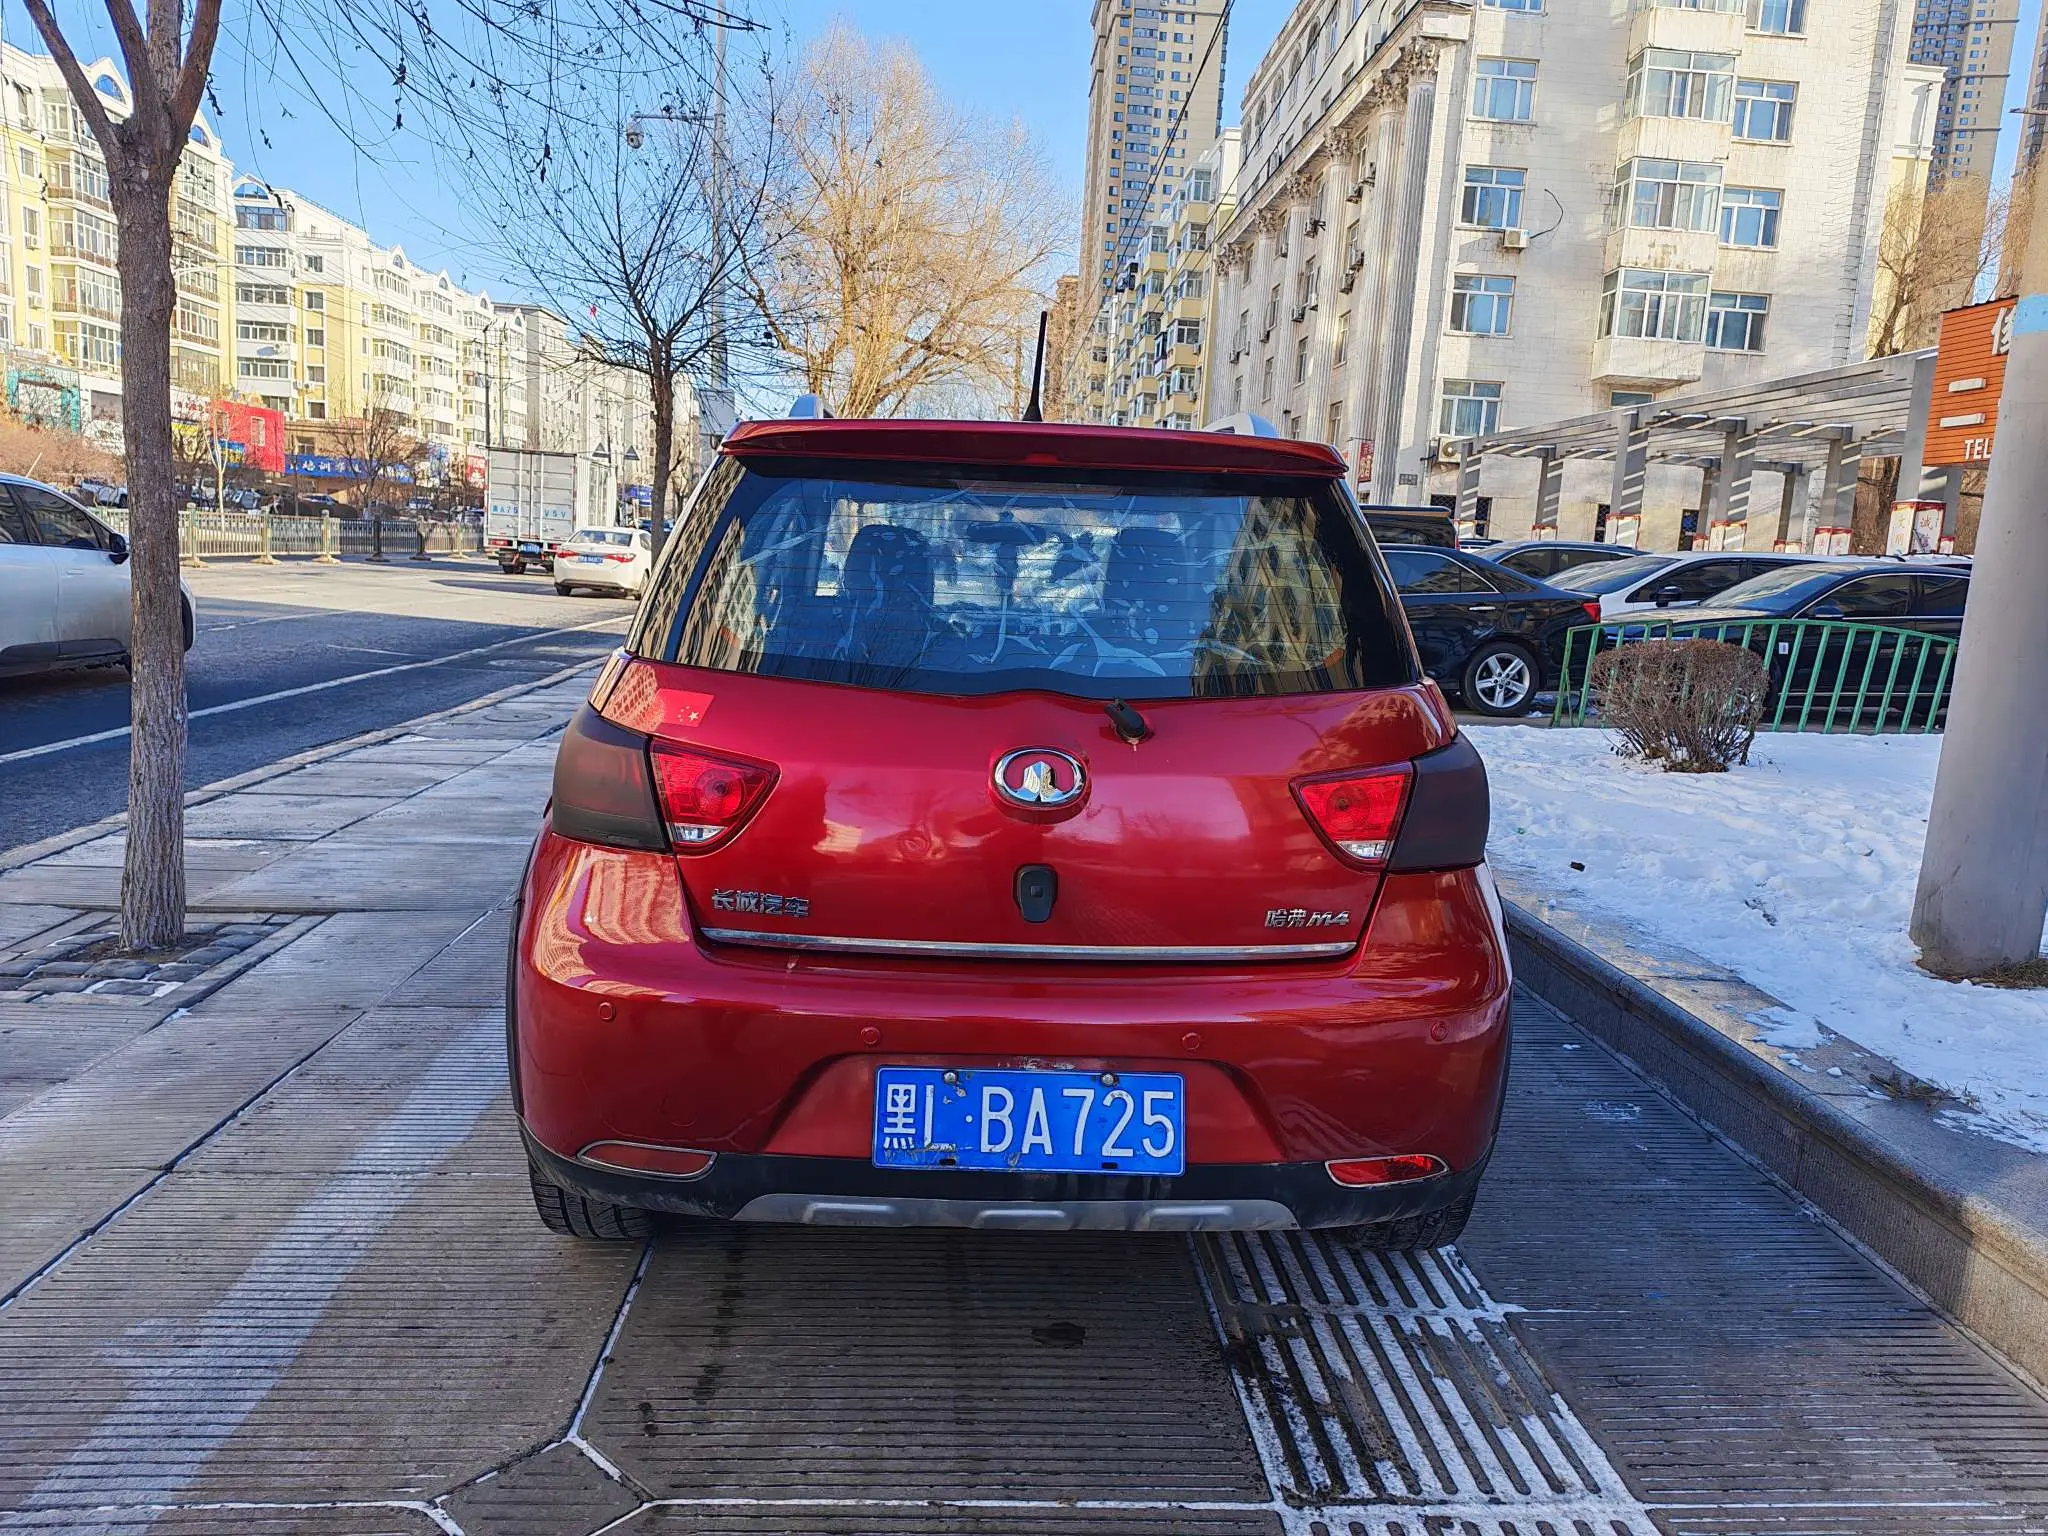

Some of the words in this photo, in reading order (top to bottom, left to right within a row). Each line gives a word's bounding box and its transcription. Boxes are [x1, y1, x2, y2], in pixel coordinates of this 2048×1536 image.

[1964, 438, 1992, 460] TEL
[712, 888, 809, 917] 长城汽车
